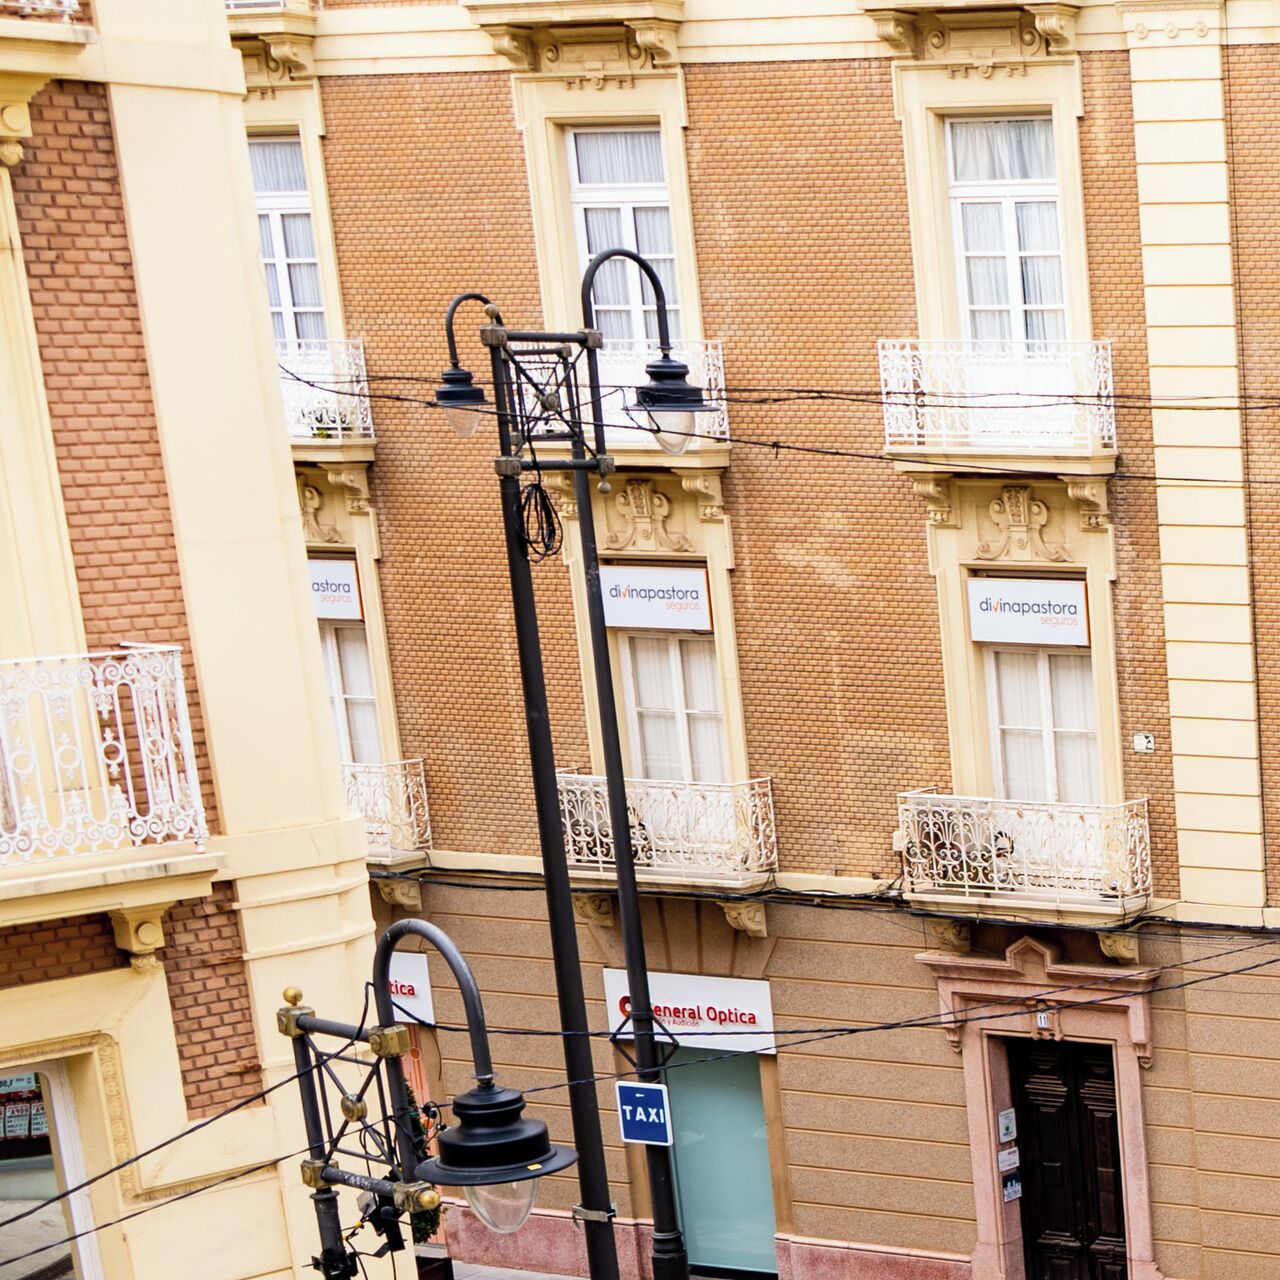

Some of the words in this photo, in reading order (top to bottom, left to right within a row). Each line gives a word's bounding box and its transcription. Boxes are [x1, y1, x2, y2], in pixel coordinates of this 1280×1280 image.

[312, 579, 350, 593] astora
[609, 585, 699, 602] divinapastora
[666, 602, 700, 612] seguros
[979, 597, 1078, 616] divinapastora
[1040, 616, 1078, 627] seguros
[388, 980, 416, 996] tica
[652, 1004, 702, 1021] eneral
[706, 1006, 757, 1026] Optica
[622, 1105, 665, 1123] TAXI
